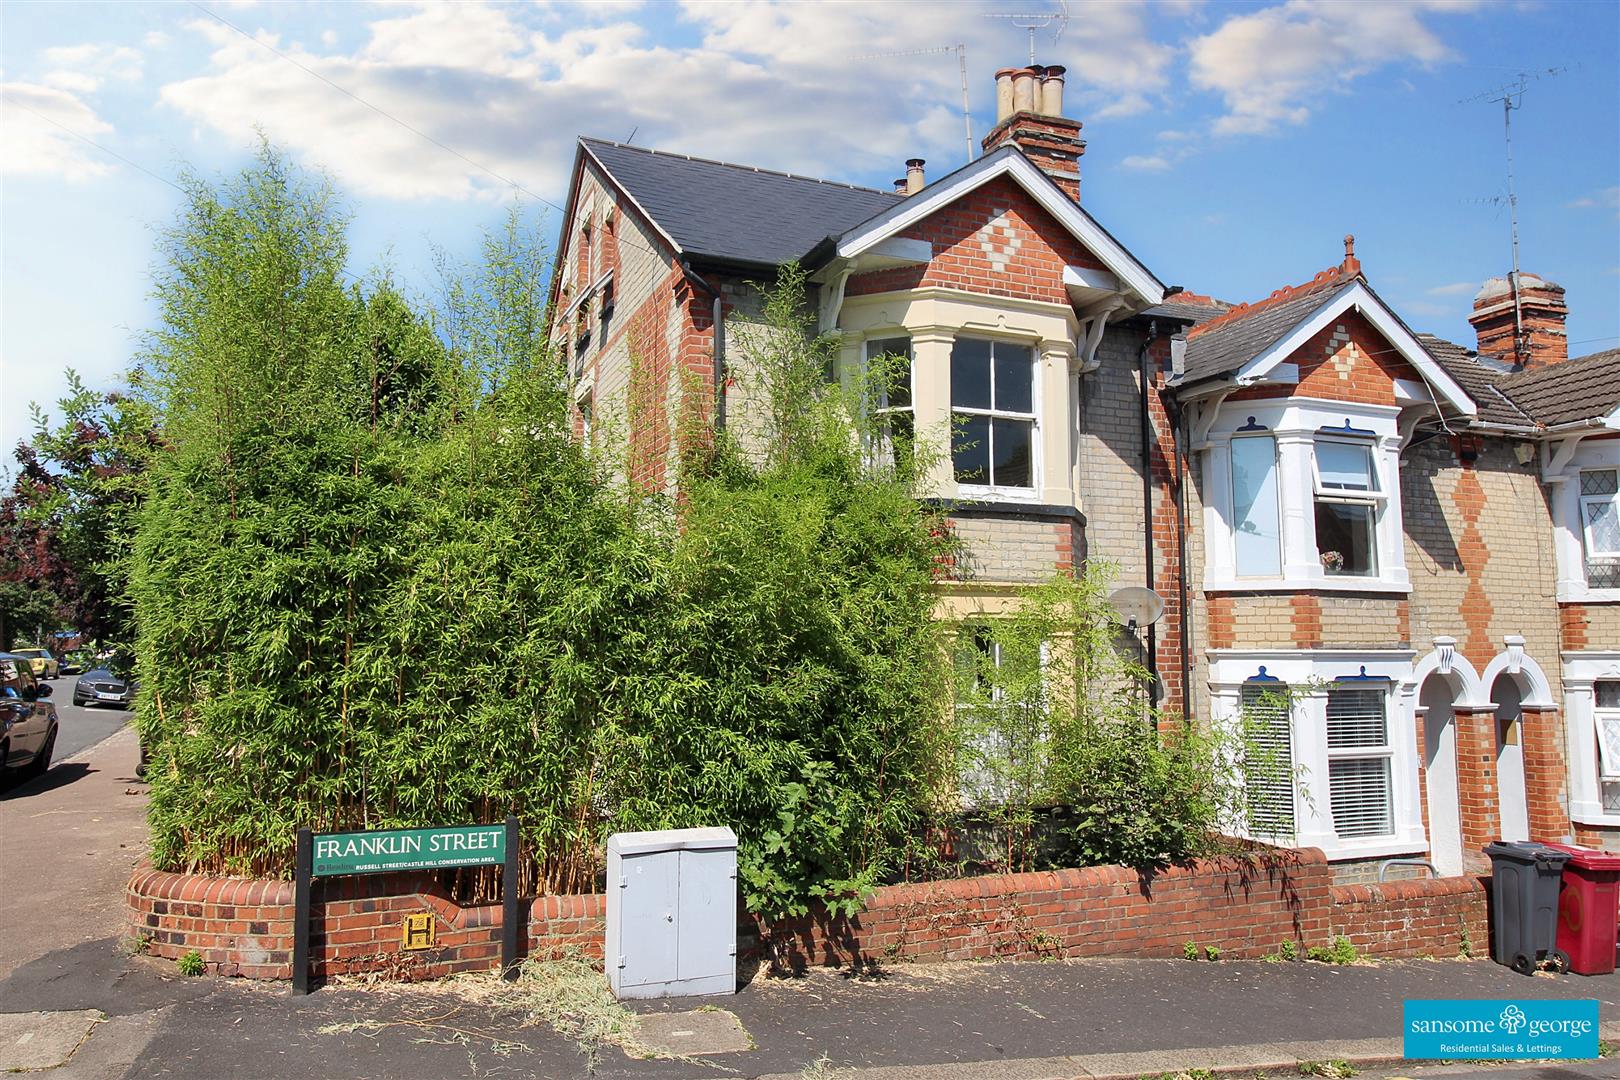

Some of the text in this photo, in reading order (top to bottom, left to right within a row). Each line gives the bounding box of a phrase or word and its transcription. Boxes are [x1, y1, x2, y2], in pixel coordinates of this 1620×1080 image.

[316, 831, 502, 859] FRANKLIN STREET
[382, 860, 424, 869] STREET/CASTLE
[438, 857, 480, 865] CONSERVATION
[407, 916, 431, 947] H
